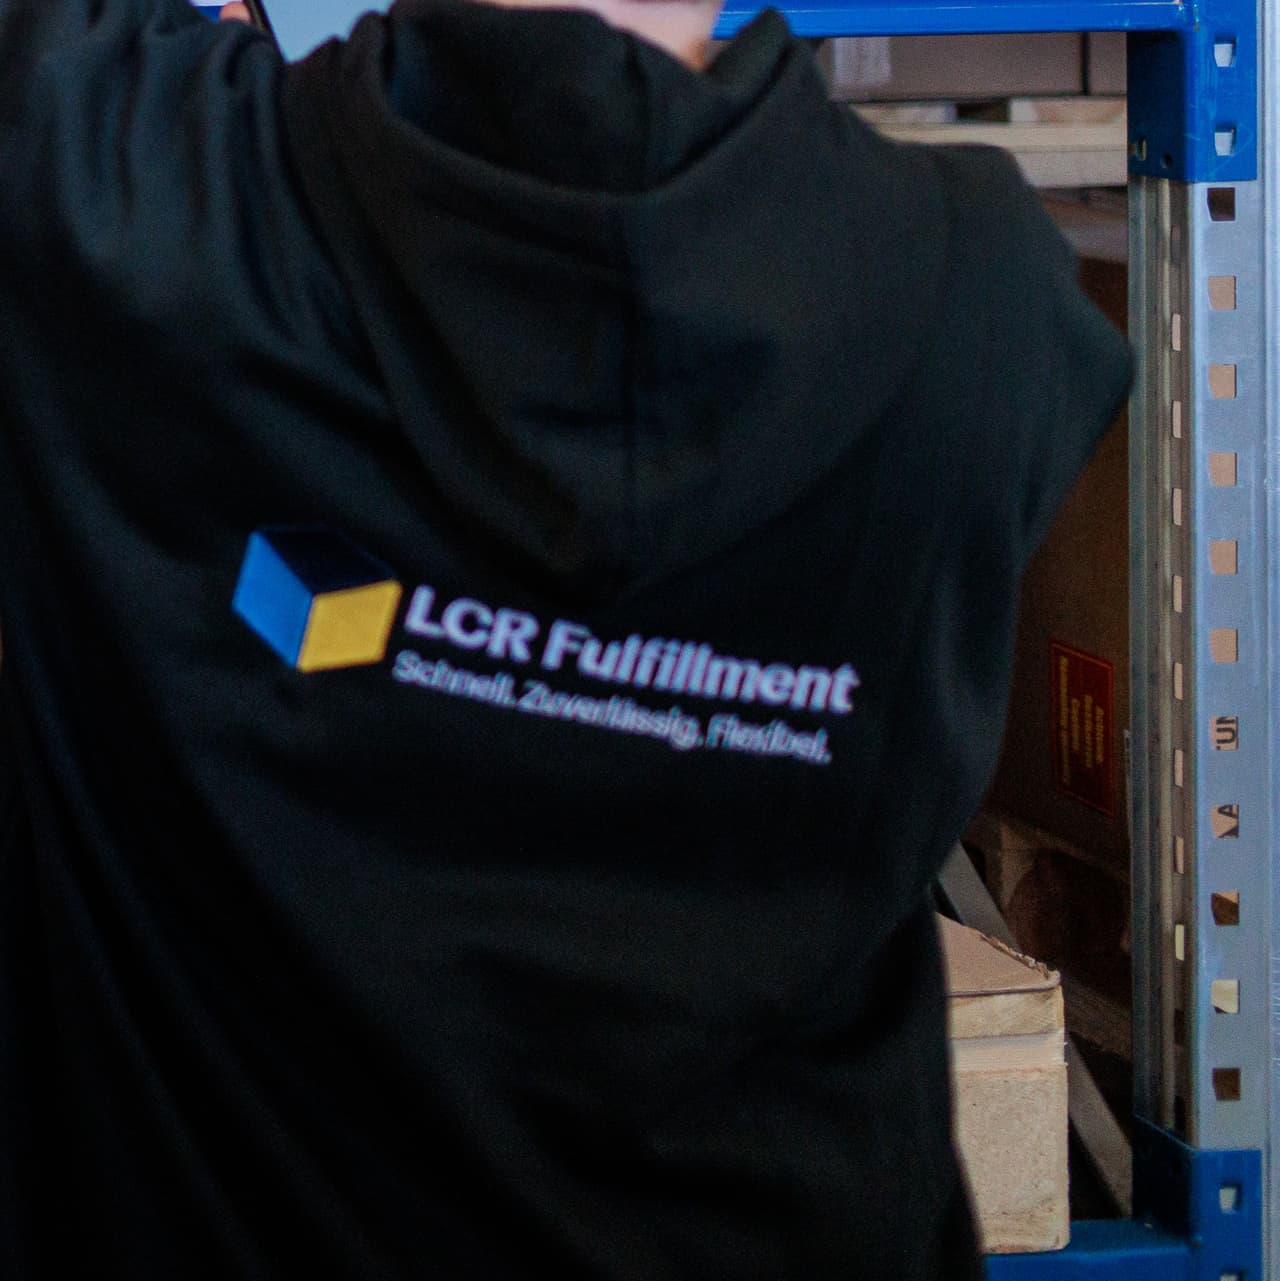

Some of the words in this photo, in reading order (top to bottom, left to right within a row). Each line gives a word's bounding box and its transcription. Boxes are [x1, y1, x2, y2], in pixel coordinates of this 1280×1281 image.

[392, 649, 517, 707] Schnell.
[404, 584, 540, 663] LCR
[542, 619, 860, 714] Fulfillment
